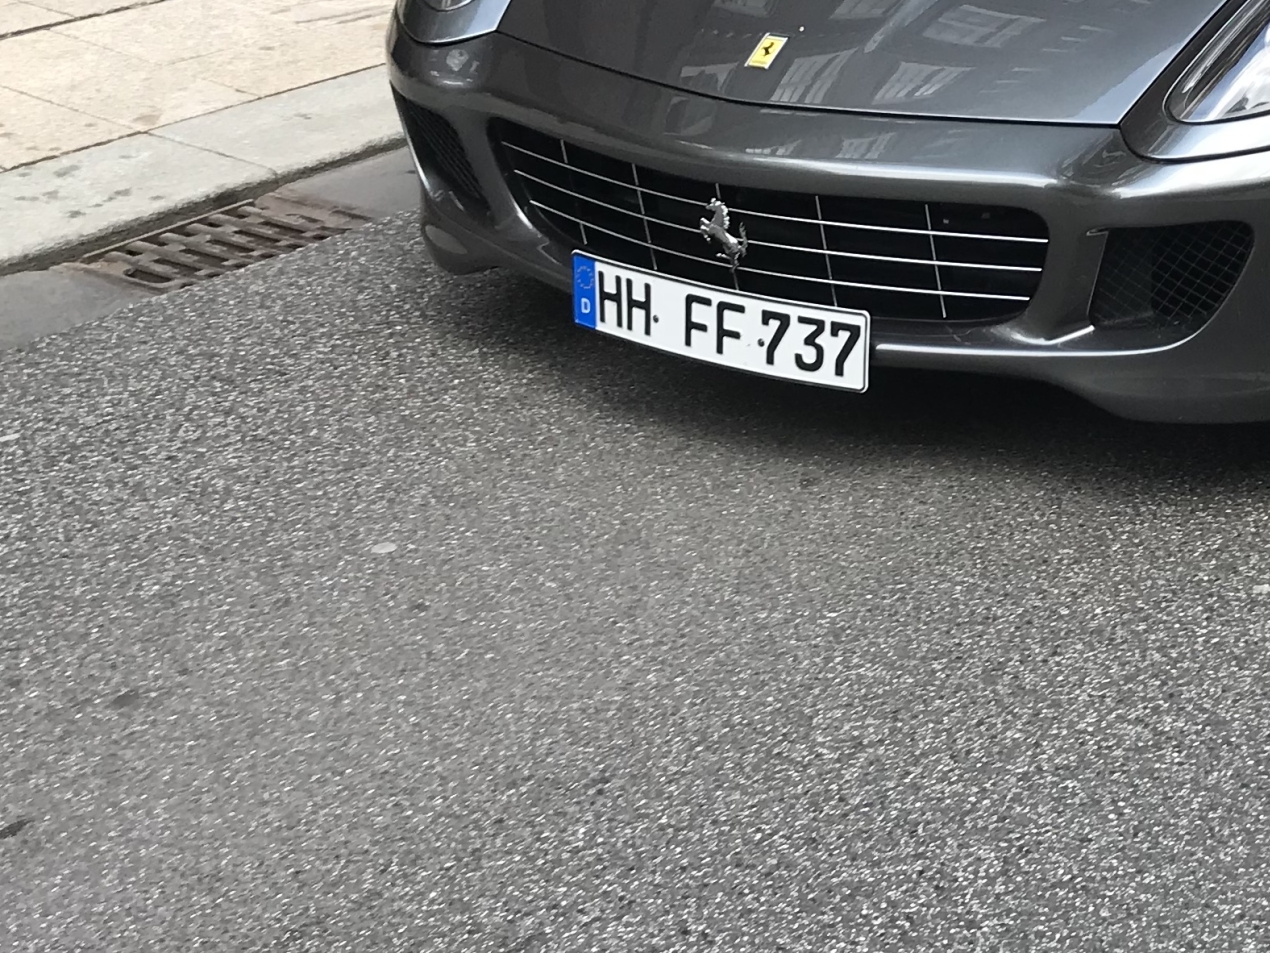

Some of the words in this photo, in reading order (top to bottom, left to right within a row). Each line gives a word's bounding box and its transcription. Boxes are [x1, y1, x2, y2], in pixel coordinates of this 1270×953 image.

[580, 298, 591, 314] D
[598, 270, 652, 336] HH
[685, 293, 746, 356] FF
[761, 309, 862, 378] 737
